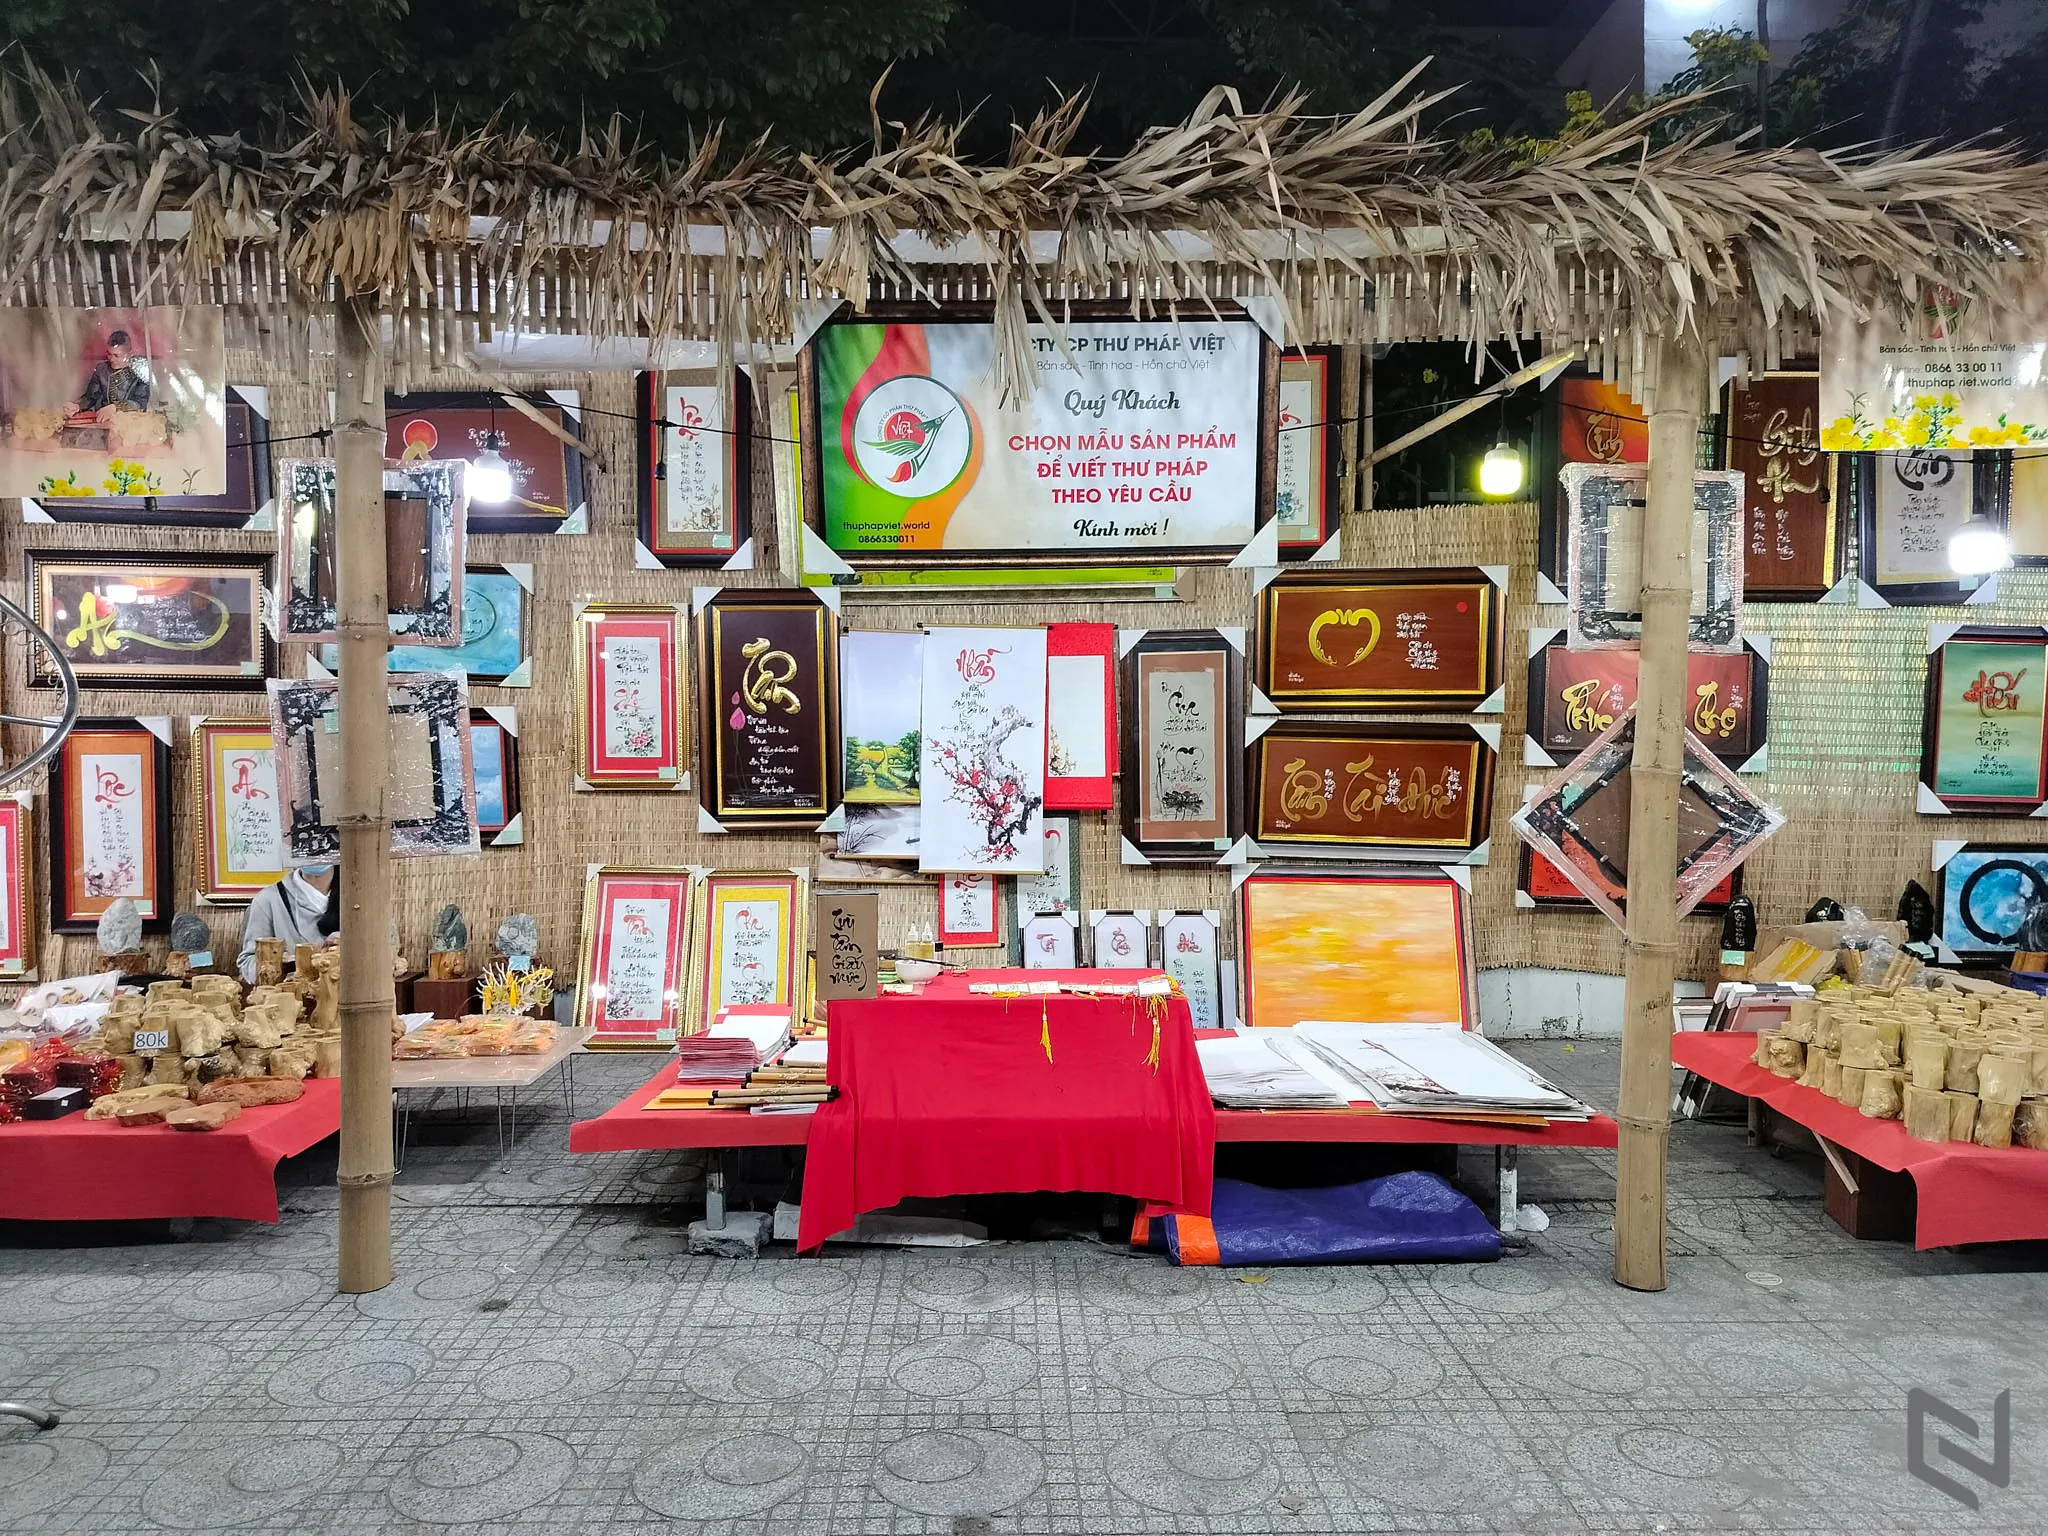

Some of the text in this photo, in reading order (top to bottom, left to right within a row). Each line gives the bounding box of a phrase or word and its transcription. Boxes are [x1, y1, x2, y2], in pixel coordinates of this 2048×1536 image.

[1093, 336, 1130, 352] THƯ
[1188, 332, 1226, 355] VIỆT
[1112, 361, 1133, 370] hoa
[1924, 363, 1952, 373] 0866
[1956, 363, 1970, 373] 33
[1972, 363, 1987, 373] 00
[1990, 363, 2002, 373] 11
[1063, 388, 1181, 418] Quý Khách
[1007, 424, 1237, 455] CHỌN MẪU SẢN PHẨM
[1036, 454, 1209, 478] ĐỂ VIẾT THƯ PHÁP
[1051, 479, 1193, 504] THEO YÊU CẦU
[843, 521, 930, 531] thuphapviet.world
[1073, 518, 1119, 538] Kính
[1123, 522, 1158, 537] mời
[858, 534, 915, 543] 0866330011
[136, 1030, 167, 1047] 80k
